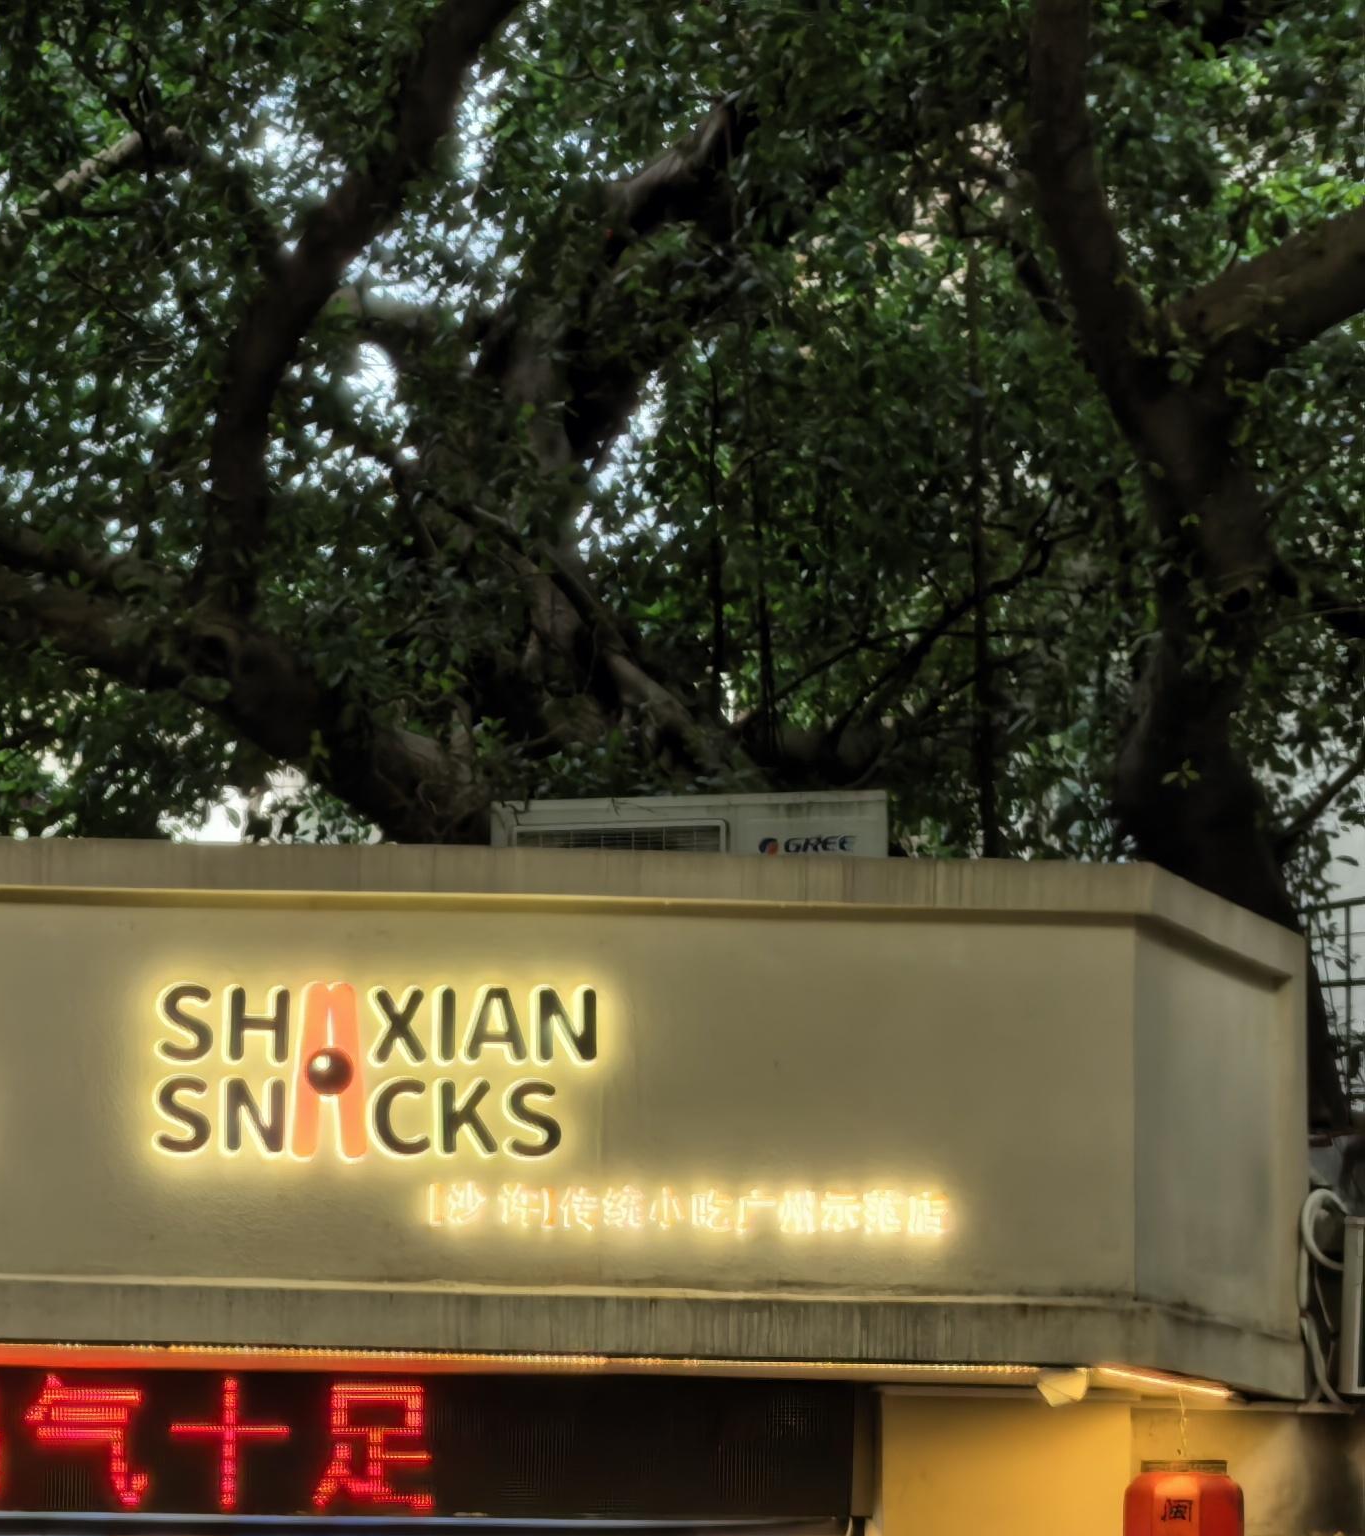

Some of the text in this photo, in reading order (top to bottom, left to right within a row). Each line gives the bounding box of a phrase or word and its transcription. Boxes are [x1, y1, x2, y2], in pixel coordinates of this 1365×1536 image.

[784, 834, 857, 853] GREE
[155, 981, 599, 1066] SHAXIAN
[153, 1076, 563, 1160] SNACKS
